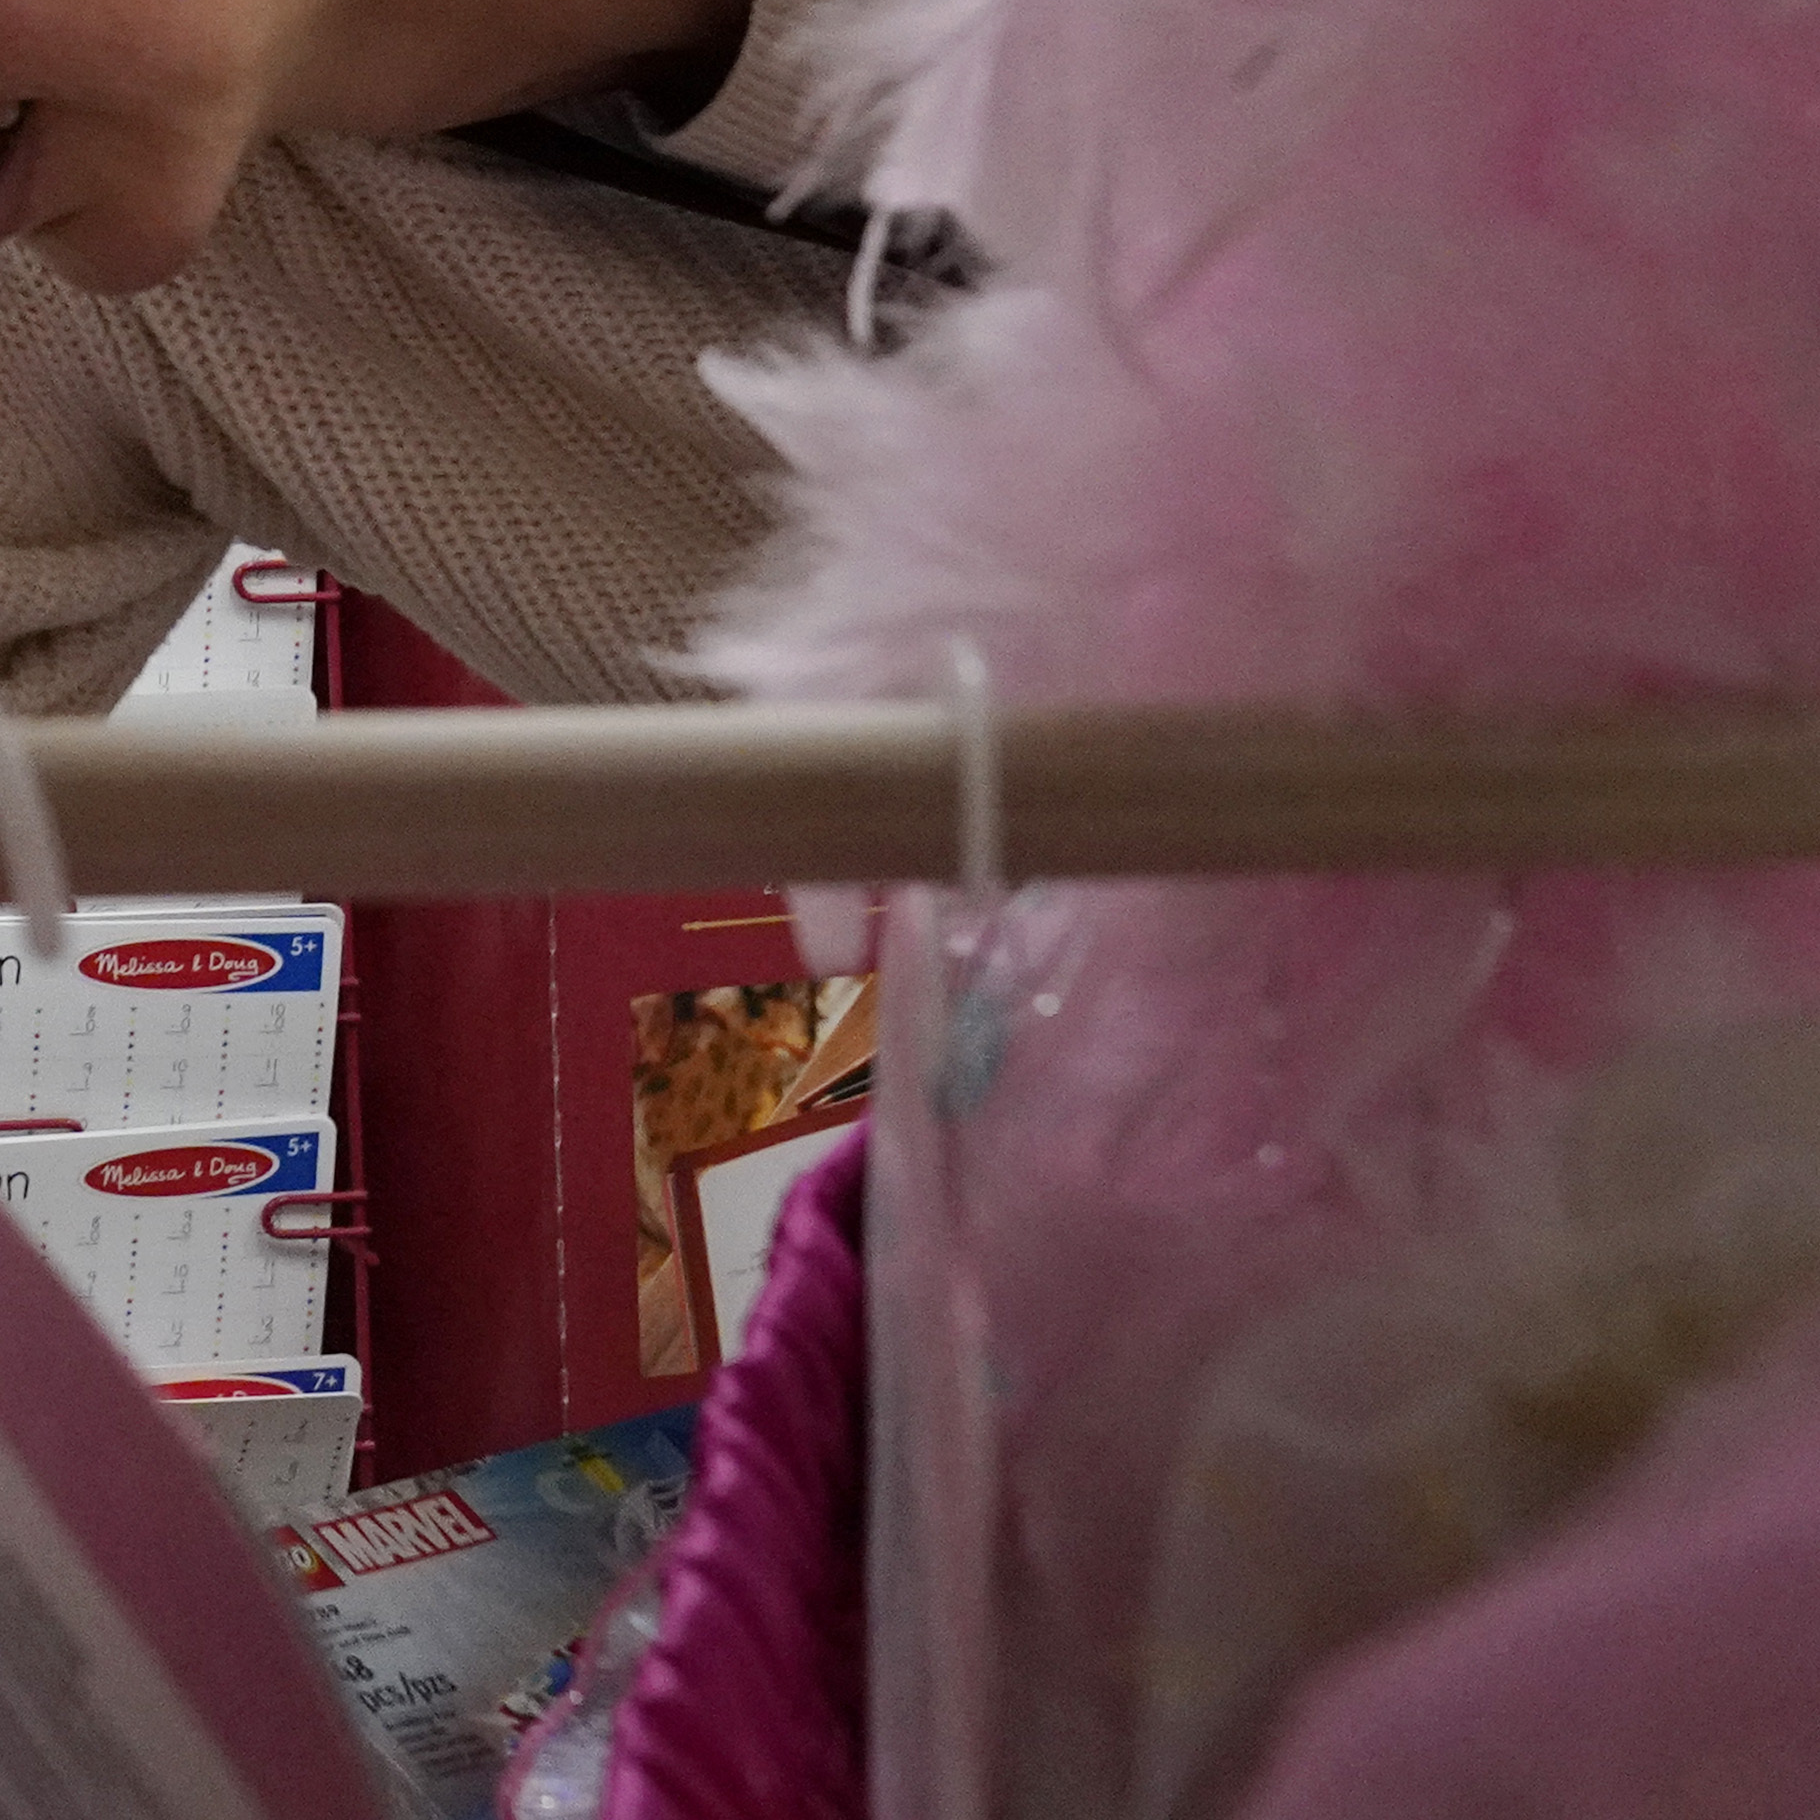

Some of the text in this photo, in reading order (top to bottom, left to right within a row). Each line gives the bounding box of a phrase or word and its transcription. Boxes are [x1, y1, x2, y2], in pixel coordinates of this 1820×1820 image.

[290, 937, 318, 956] 5+
[95, 951, 186, 980] Melissa
[208, 950, 260, 981] Doug
[286, 1137, 314, 1157] 5+
[99, 1163, 187, 1190] Melissa
[209, 1157, 258, 1186] Doug
[312, 1372, 339, 1391] 7+
[317, 1493, 496, 1573] MARVEL
